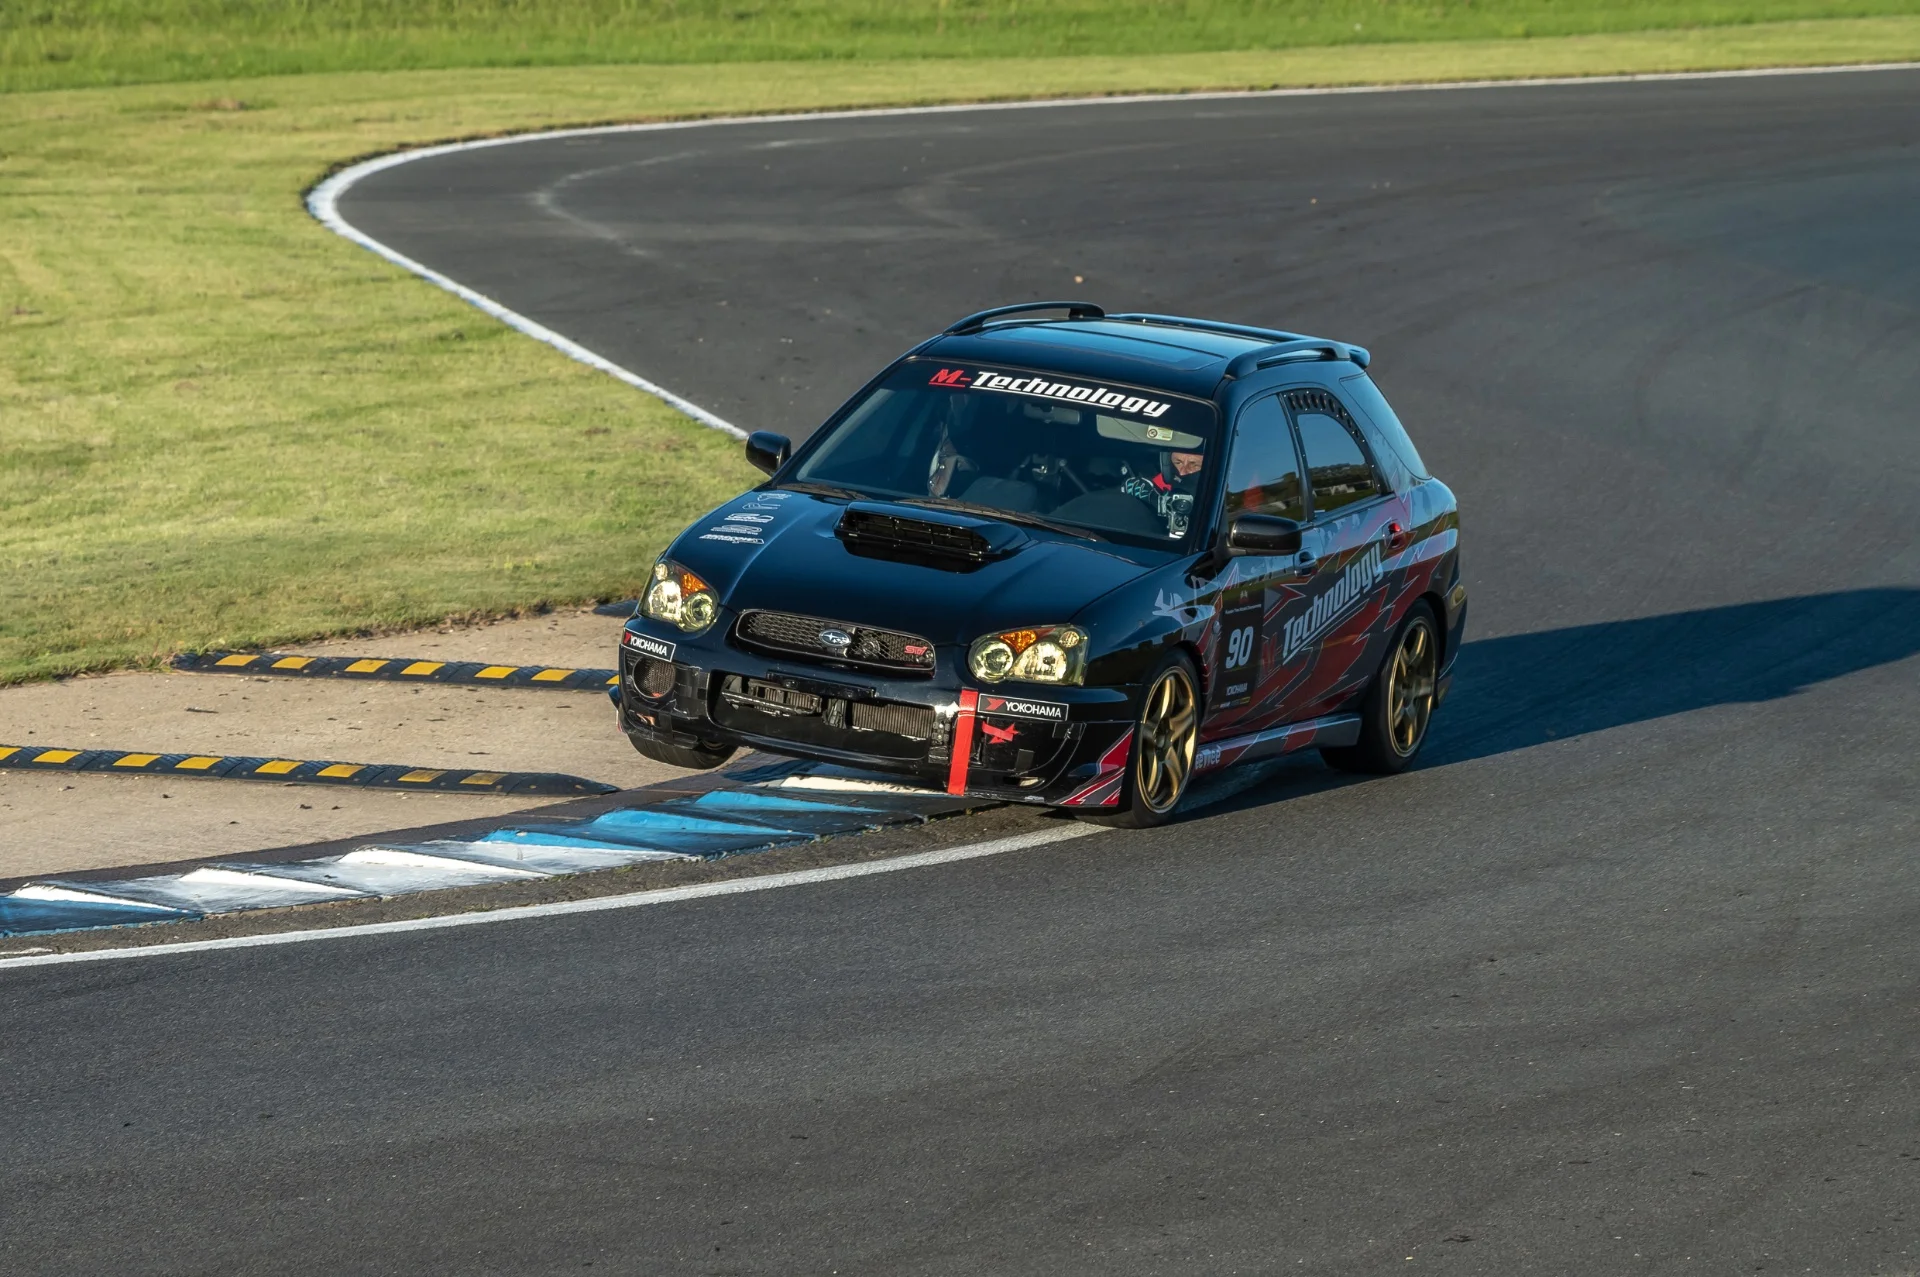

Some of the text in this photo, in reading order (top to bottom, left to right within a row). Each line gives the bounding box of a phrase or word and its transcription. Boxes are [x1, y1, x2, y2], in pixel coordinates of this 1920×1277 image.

[630, 635, 667, 656] YOKOHAMA
[1225, 626, 1254, 669] 90
[1005, 701, 1062, 718] YOKOHAMA
